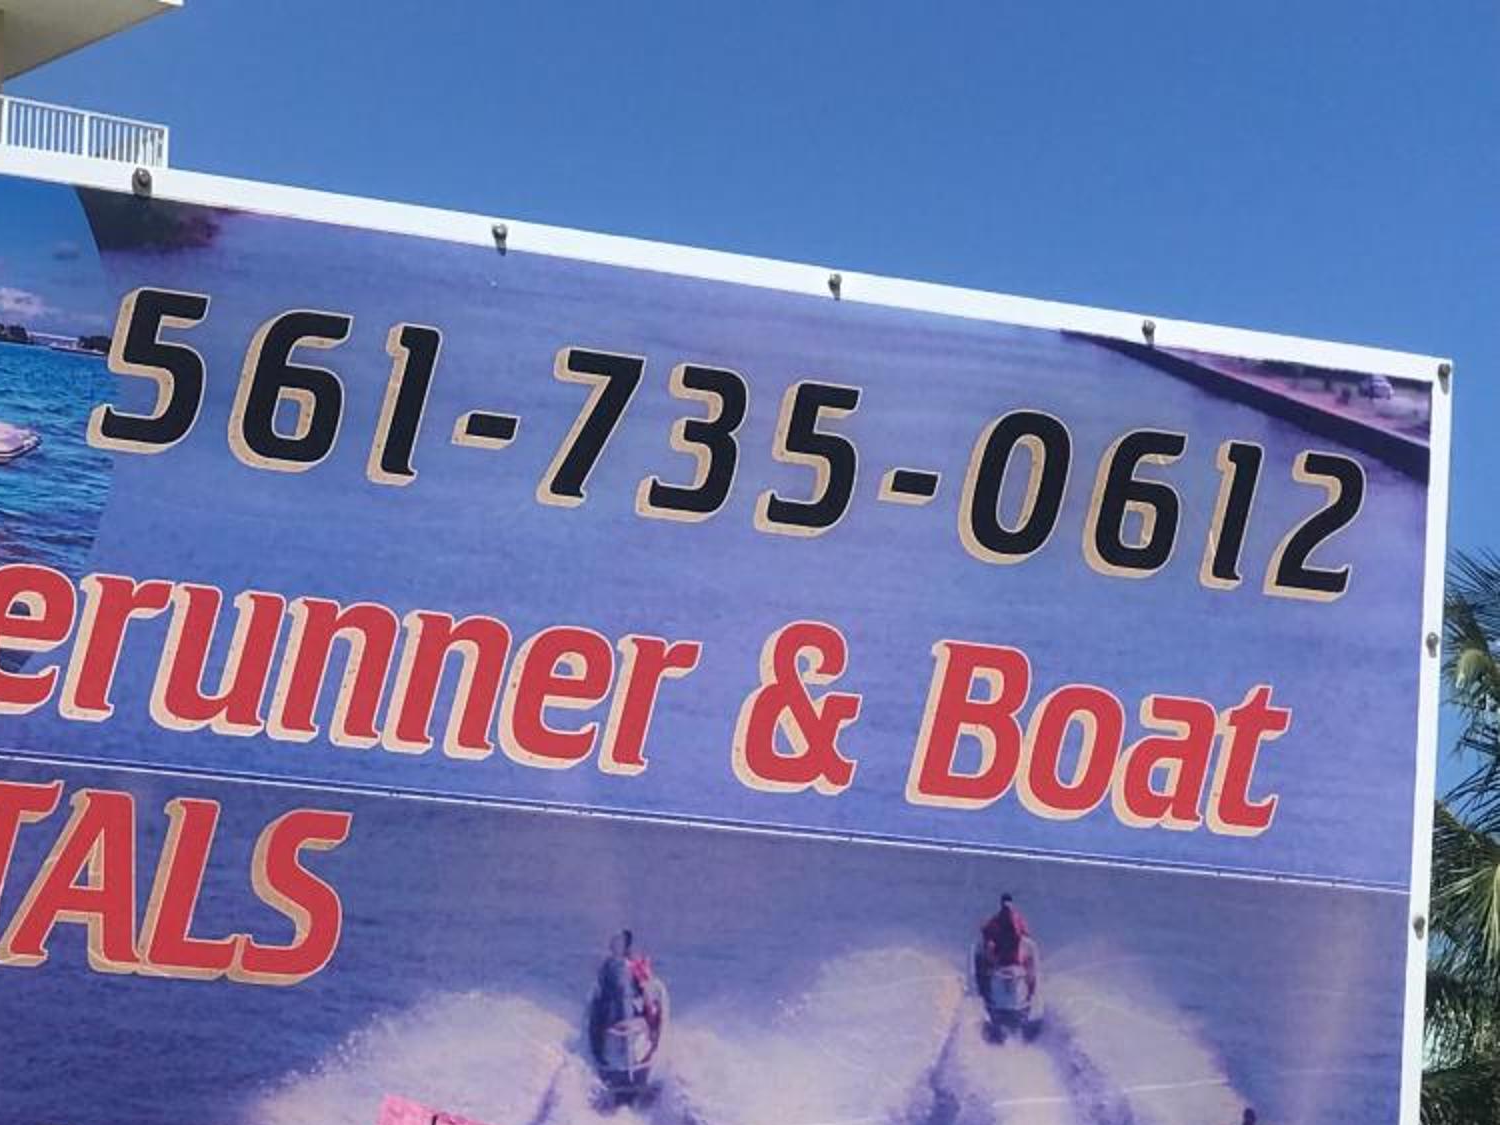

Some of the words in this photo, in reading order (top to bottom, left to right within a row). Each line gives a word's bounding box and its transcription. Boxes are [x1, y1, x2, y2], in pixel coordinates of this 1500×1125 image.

[86, 287, 1368, 602] 561-735-0612
[731, 619, 862, 795] &
[906, 638, 1292, 837] Boat
